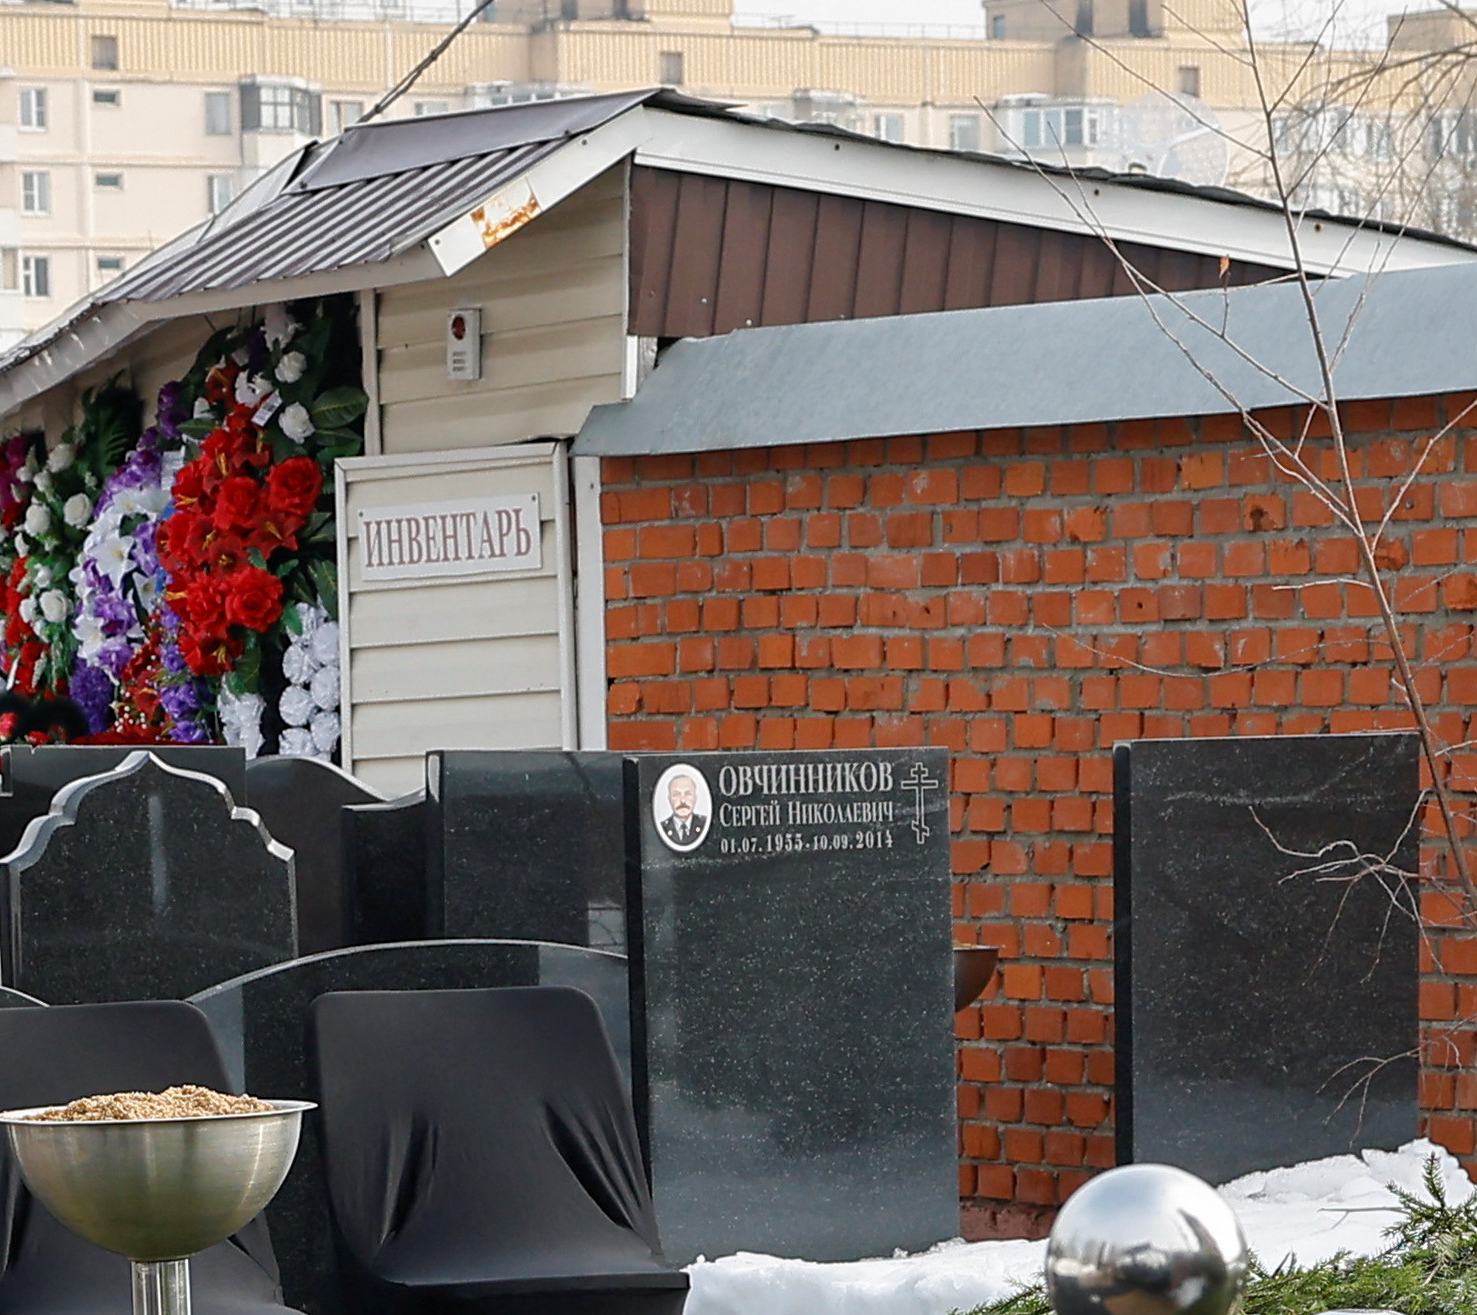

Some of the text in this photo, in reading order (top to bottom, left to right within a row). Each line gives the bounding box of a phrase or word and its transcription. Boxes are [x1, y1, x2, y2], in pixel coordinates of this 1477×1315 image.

[363, 508, 532, 568] ИНВЕНТАРЬ
[719, 762, 893, 796] ОВЧИННИКОВ
[719, 801, 893, 827] СЕРГЕЙ НИКОЛАЕВИЧ
